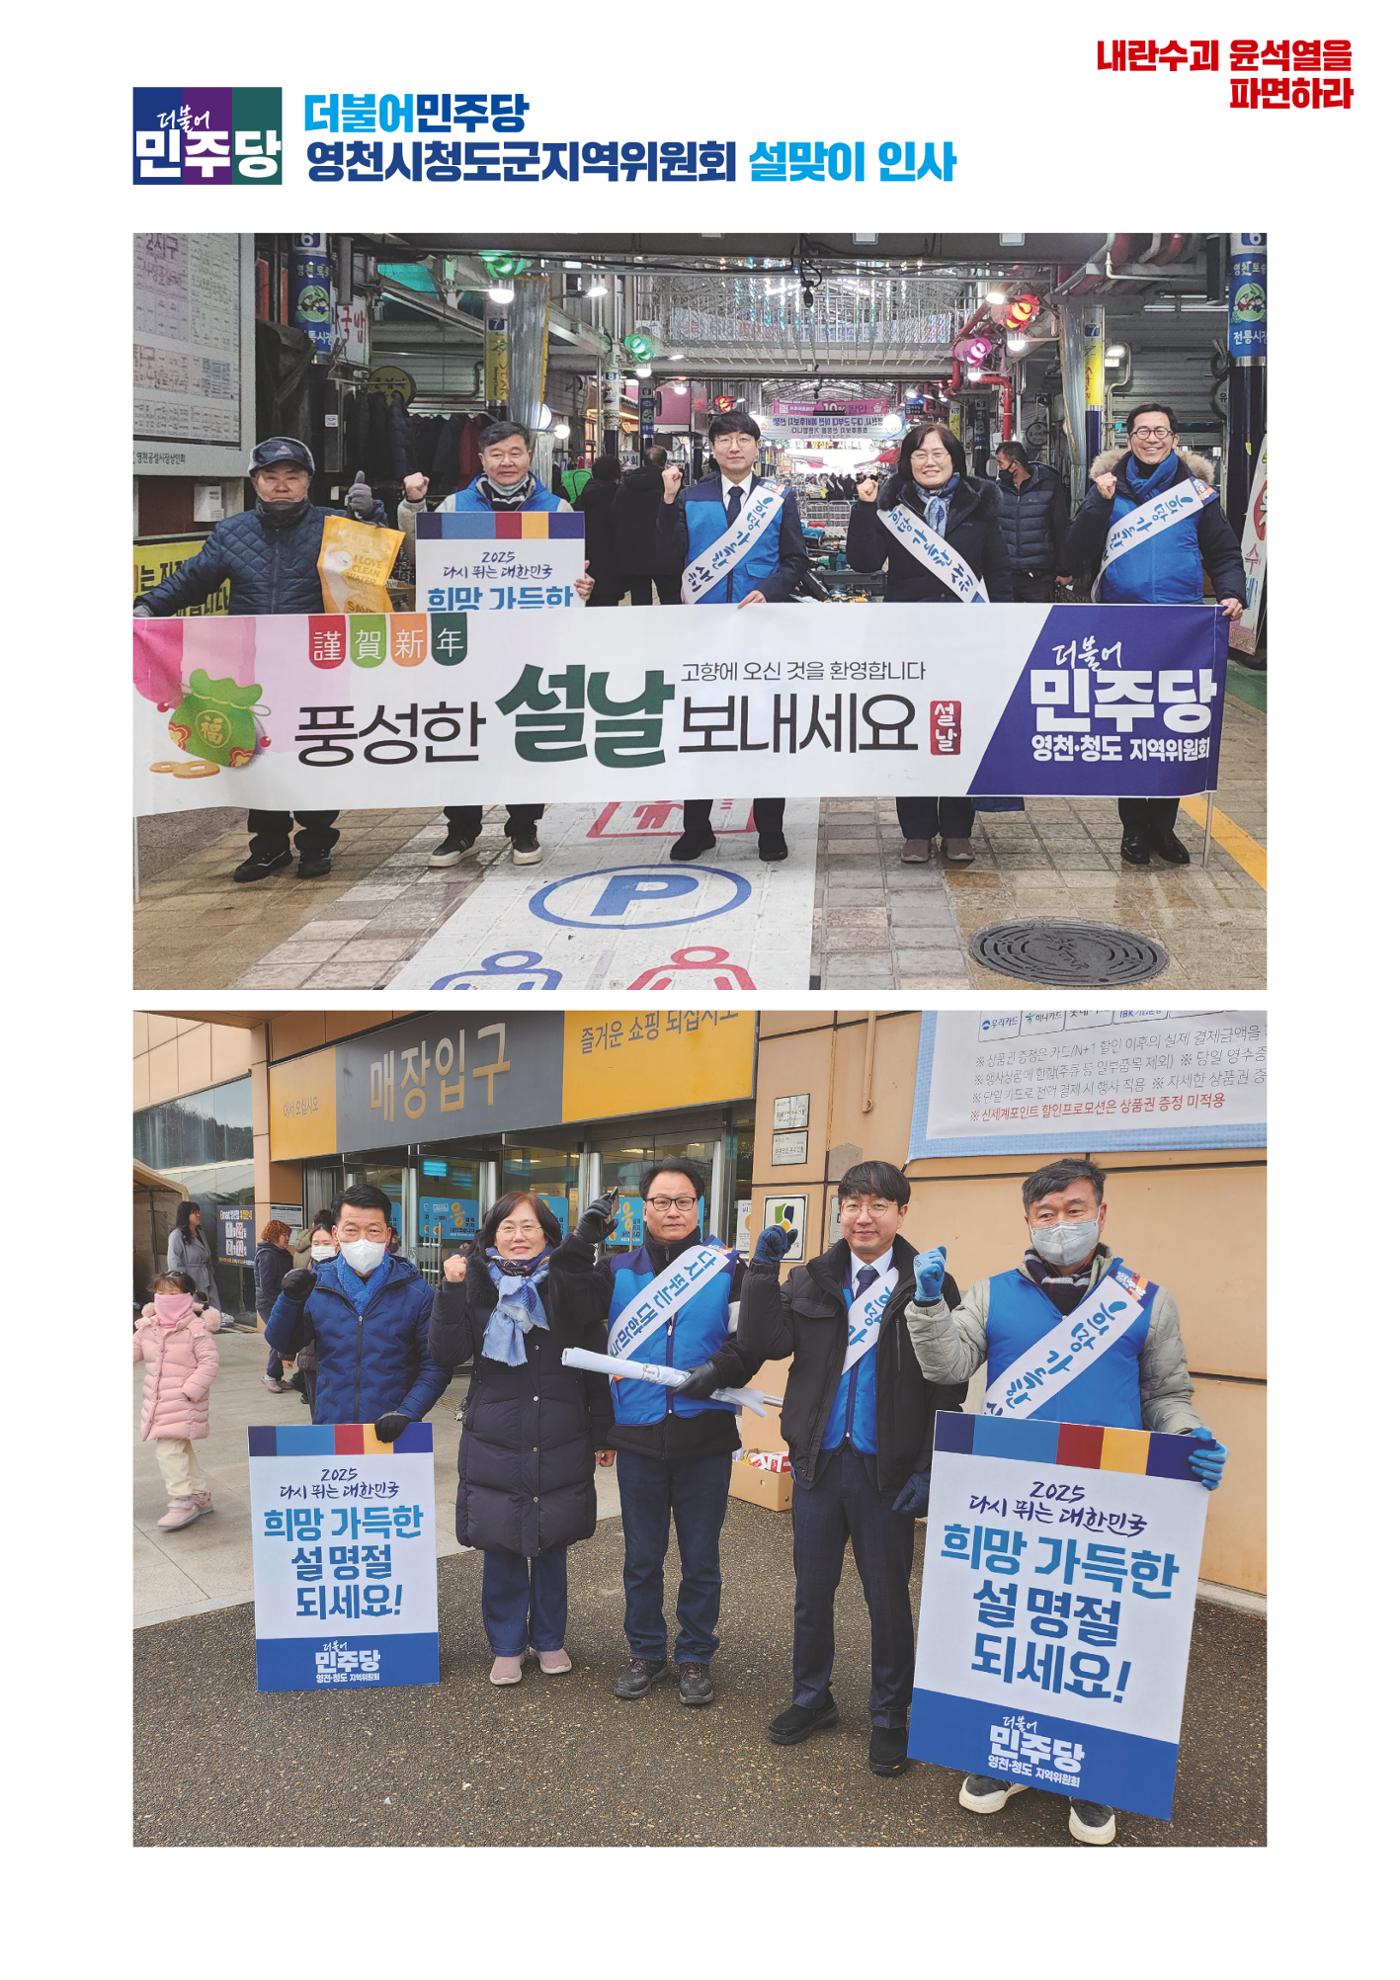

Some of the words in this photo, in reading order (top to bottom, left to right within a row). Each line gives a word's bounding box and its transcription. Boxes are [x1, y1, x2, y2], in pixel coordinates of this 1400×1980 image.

[747, 496, 774, 531] 희망
[1152, 495, 1194, 523] 희망
[1110, 517, 1153, 549] 가득한
[359, 555, 383, 568] LOVE
[481, 551, 516, 563] 2025
[711, 531, 751, 570] 가득한
[443, 565, 469, 579] 다시
[472, 566, 498, 580] 뛰는
[501, 564, 553, 580] 대한민국
[427, 586, 483, 612] 희망
[313, 626, 466, 662] 謹賀新年
[1051, 635, 1123, 671] 더불어
[680, 661, 738, 682] 고향에
[743, 661, 782, 682] 오신
[786, 661, 825, 681] 것을
[829, 661, 927, 681] 환영합니다
[294, 700, 487, 768] 풍성한
[495, 663, 676, 768] 설날
[678, 692, 919, 754] 보내세요
[933, 703, 958, 753] 설날
[1030, 668, 1218, 733] 민주당
[1031, 734, 1123, 762] 영천·청도
[1129, 736, 1211, 762] 지역위원회
[591, 873, 699, 917] P
[992, 1016, 1018, 1029] 우리카드
[987, 1052, 1016, 1067] 상품권
[1101, 1037, 1122, 1055] 할인
[1125, 1033, 1161, 1051] 이후의
[1165, 1031, 1190, 1049] 실제
[1194, 1024, 1261, 1046] 결제금액을
[1197, 1049, 1224, 1067] 당일
[369, 1022, 512, 1122] 매장입구
[580, 1020, 624, 1055] 즐거운
[628, 1011, 660, 1041] 쇼핑
[1060, 1083, 1081, 1098] 결제
[1123, 1077, 1146, 1093] 적용
[1168, 1072, 1206, 1089] 자세한
[1209, 1069, 1250, 1087] 상품권
[982, 1105, 1039, 1122] 신세계포인트
[1042, 1099, 1117, 1118] 할인프로모션은
[1120, 1097, 1155, 1114] 상품권
[1159, 1095, 1183, 1112] 증정
[1187, 1091, 1225, 1109] 미적용
[684, 1250, 717, 1282] 다시
[653, 1272, 690, 1309] 뛰는
[1070, 1300, 1128, 1354] 희망
[1004, 1350, 1071, 1410] 가득한
[280, 1484, 307, 1499] 다시
[312, 1483, 339, 1499] 뛰는
[343, 1481, 400, 1499] 대한민국
[321, 1467, 358, 1482] 2025
[1031, 1480, 1086, 1503] 2025
[264, 1507, 325, 1542] 희망
[331, 1504, 424, 1541] 가득한
[968, 1494, 1008, 1515] 다시
[1012, 1501, 1055, 1524] 뛰는
[1058, 1506, 1149, 1538] 대한민국
[291, 1545, 323, 1582] 설
[329, 1544, 392, 1581] 명절
[940, 1523, 1028, 1577] 희망
[1034, 1536, 1180, 1600] 가득한
[296, 1583, 403, 1620] 되세요!
[972, 1578, 1019, 1629] 설
[1026, 1586, 1122, 1648] 명절
[315, 1650, 381, 1674] 민주당
[322, 1640, 348, 1653] 더불어
[970, 1632, 1132, 1704] 되세요!
[1002, 1714, 1038, 1733] 더불어
[988, 1724, 1086, 1775] 민주당
[1035, 1766, 1081, 1789] 지역위원회
